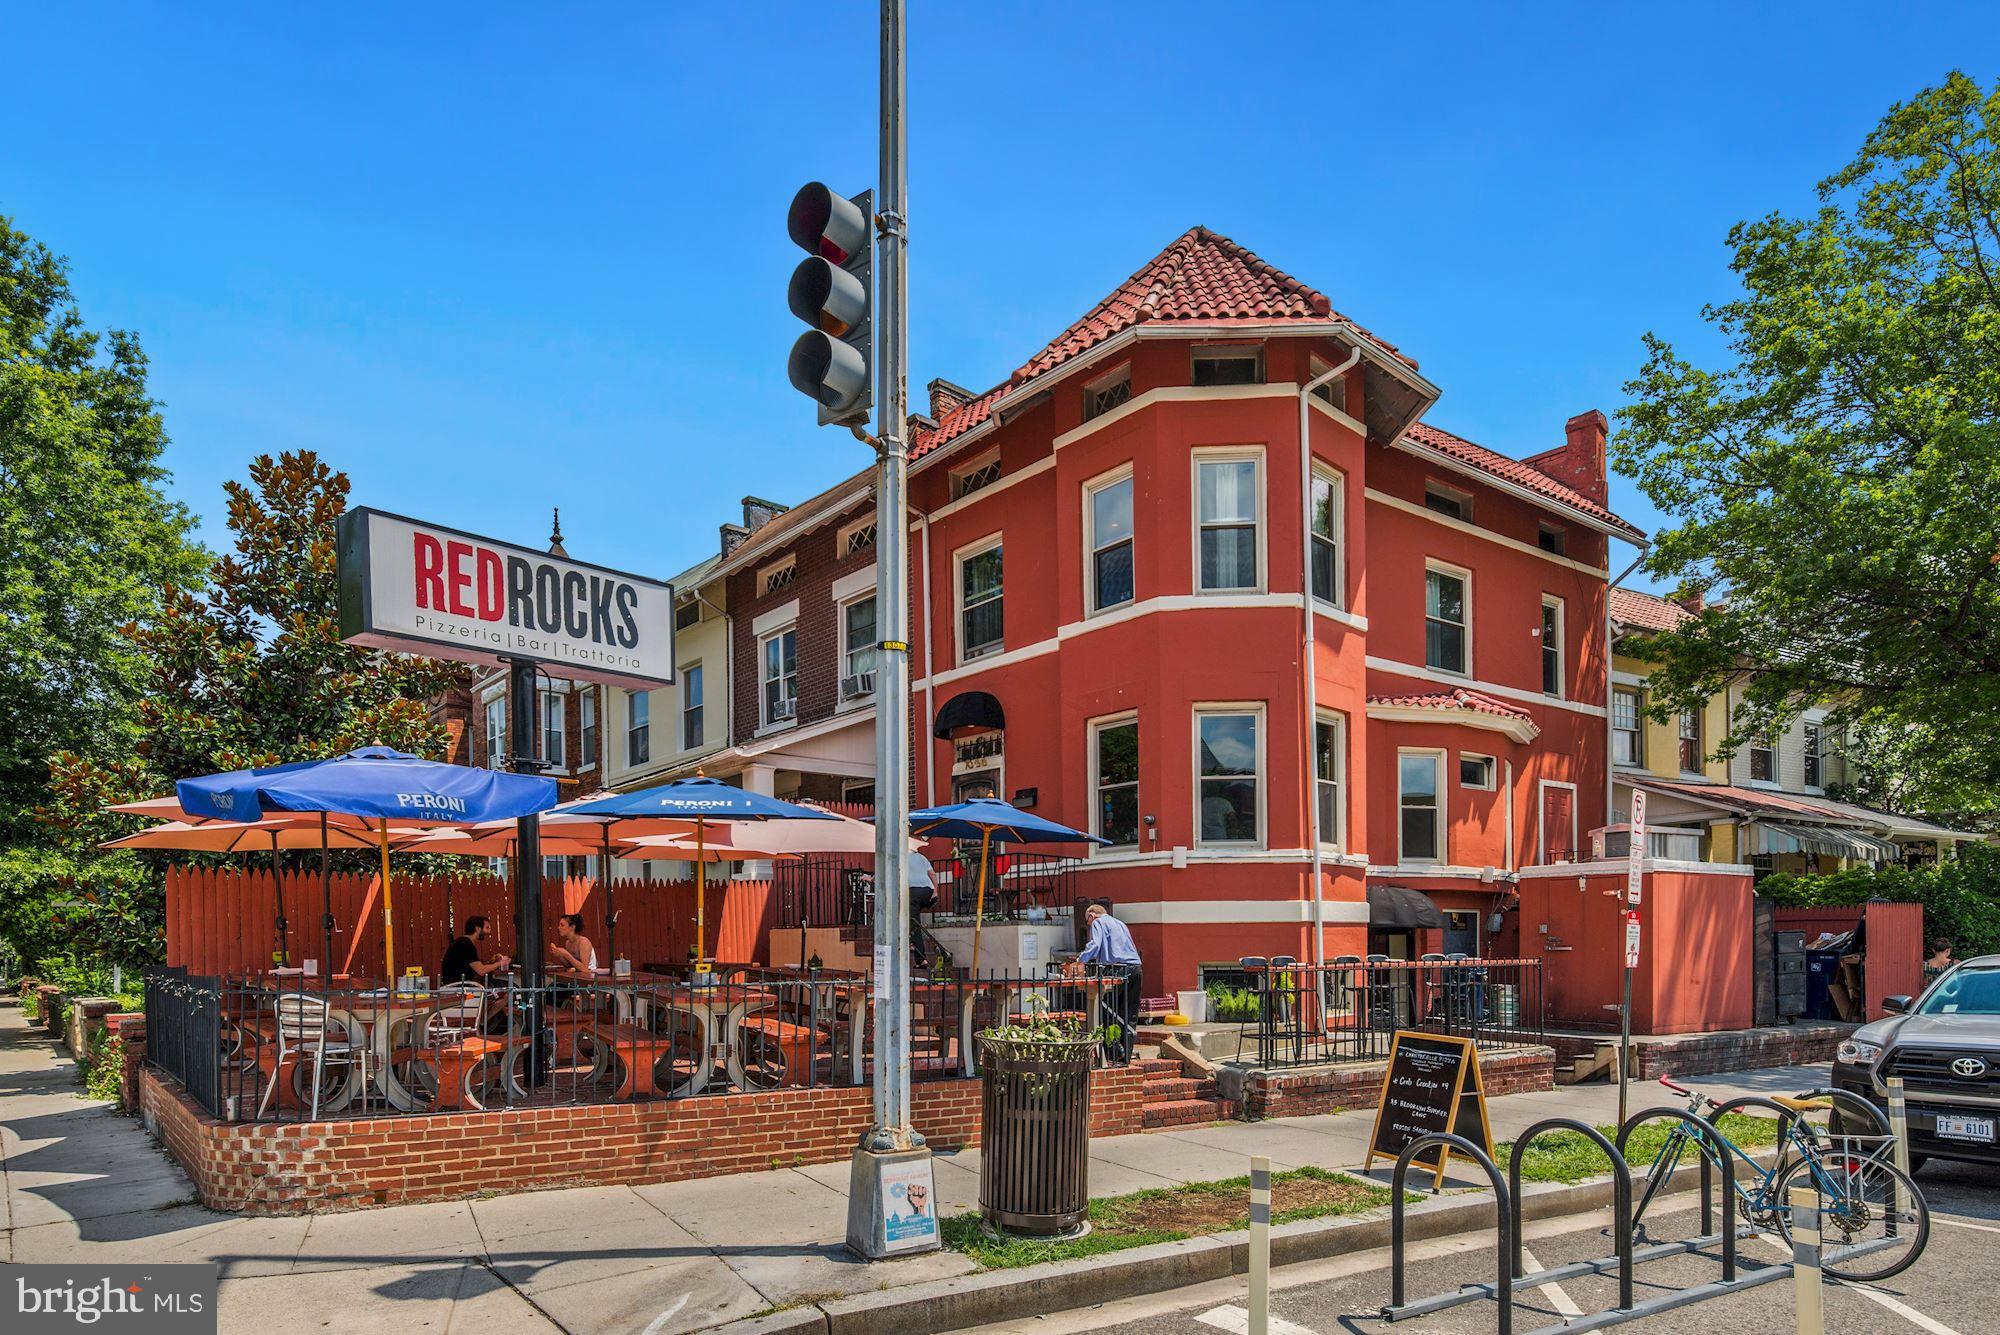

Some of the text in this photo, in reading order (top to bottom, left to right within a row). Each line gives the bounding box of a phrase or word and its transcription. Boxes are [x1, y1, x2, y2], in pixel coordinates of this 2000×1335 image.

[413, 531, 639, 650] REDROCKS
[396, 793, 466, 813] PERONI
[660, 799, 733, 807] PERONI
[420, 811, 453, 821] ITALY
[1399, 1099, 1427, 1112] BROOKLYN
[1426, 1105, 1449, 1118] SUMMER
[1938, 1120, 1990, 1135] FF 6101
